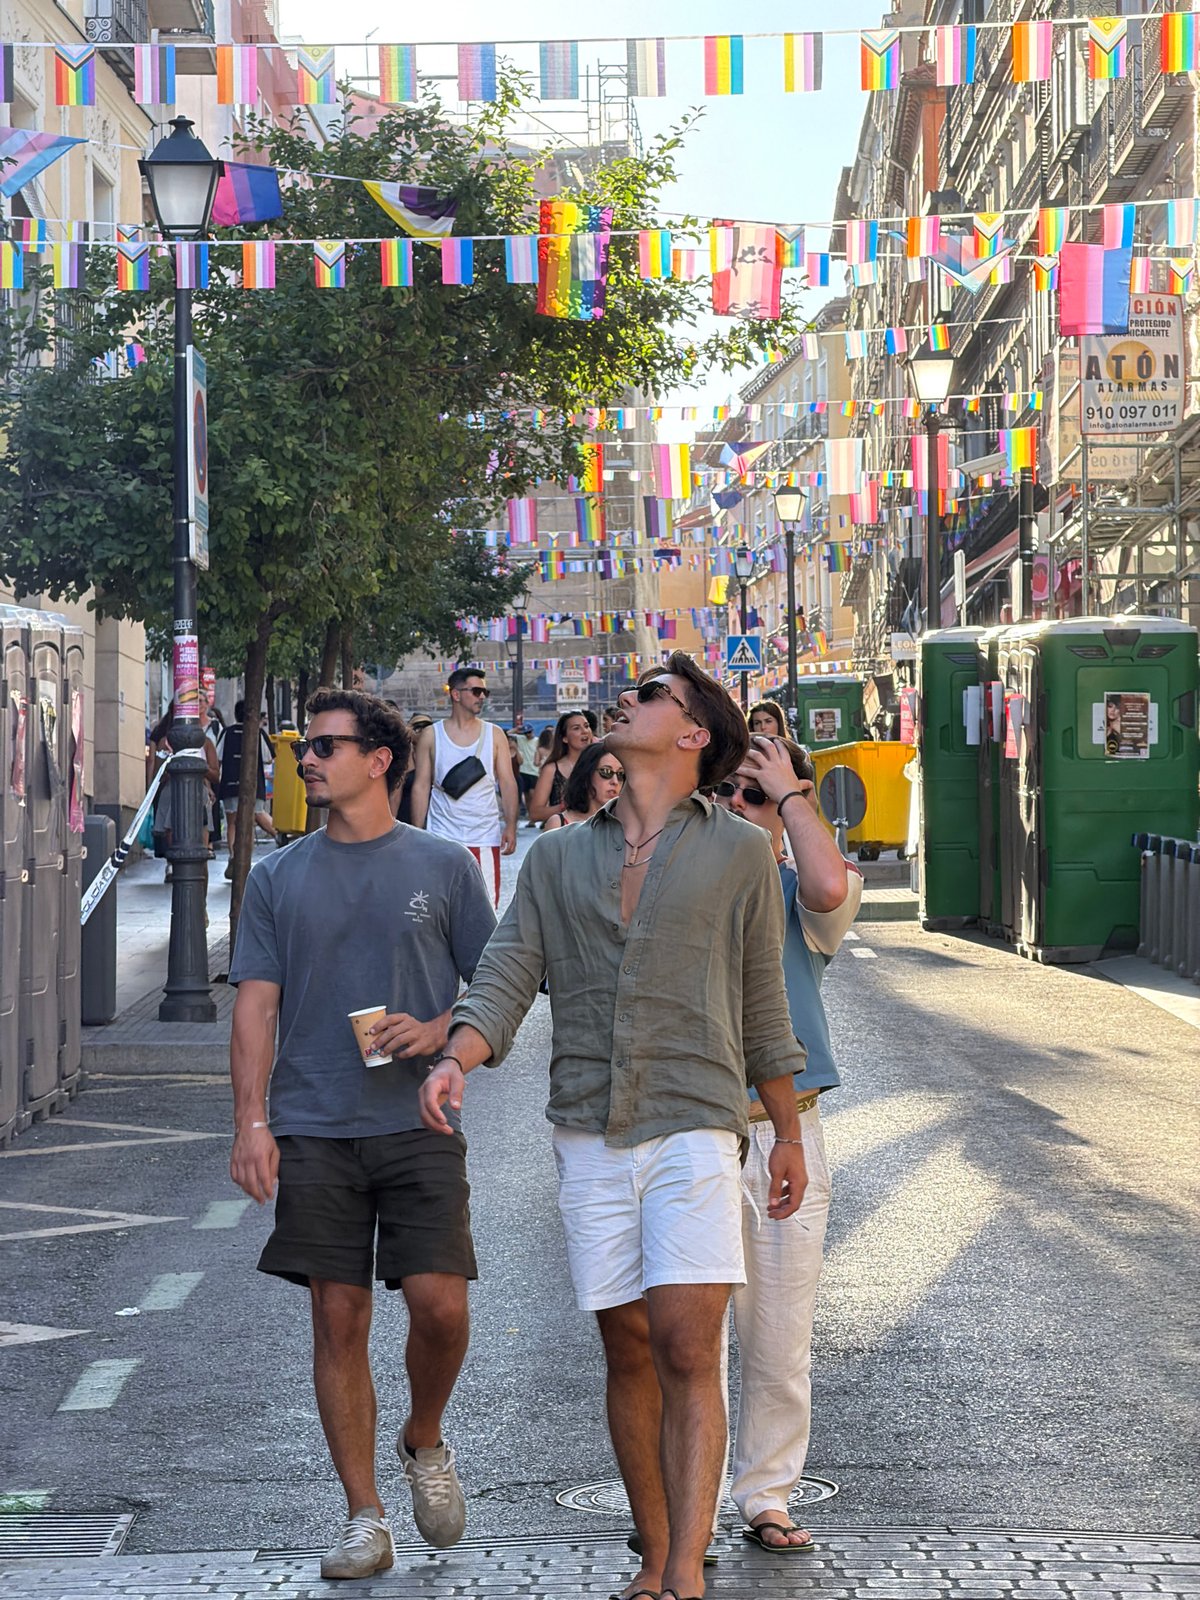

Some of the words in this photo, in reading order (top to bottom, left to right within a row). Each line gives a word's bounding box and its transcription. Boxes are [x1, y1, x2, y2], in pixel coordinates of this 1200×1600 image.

[1133, 298, 1177, 316] CIÓN
[1129, 319, 1172, 329] PROTEGIDO
[1085, 350, 1179, 380] ATÓN
[1097, 381, 1168, 393] ALARMAS
[1086, 406, 1114, 420] 910
[1119, 405, 1147, 419] 097
[1152, 404, 1177, 418] 011
[1089, 420, 1174, 430] info@atonalarmas.com
